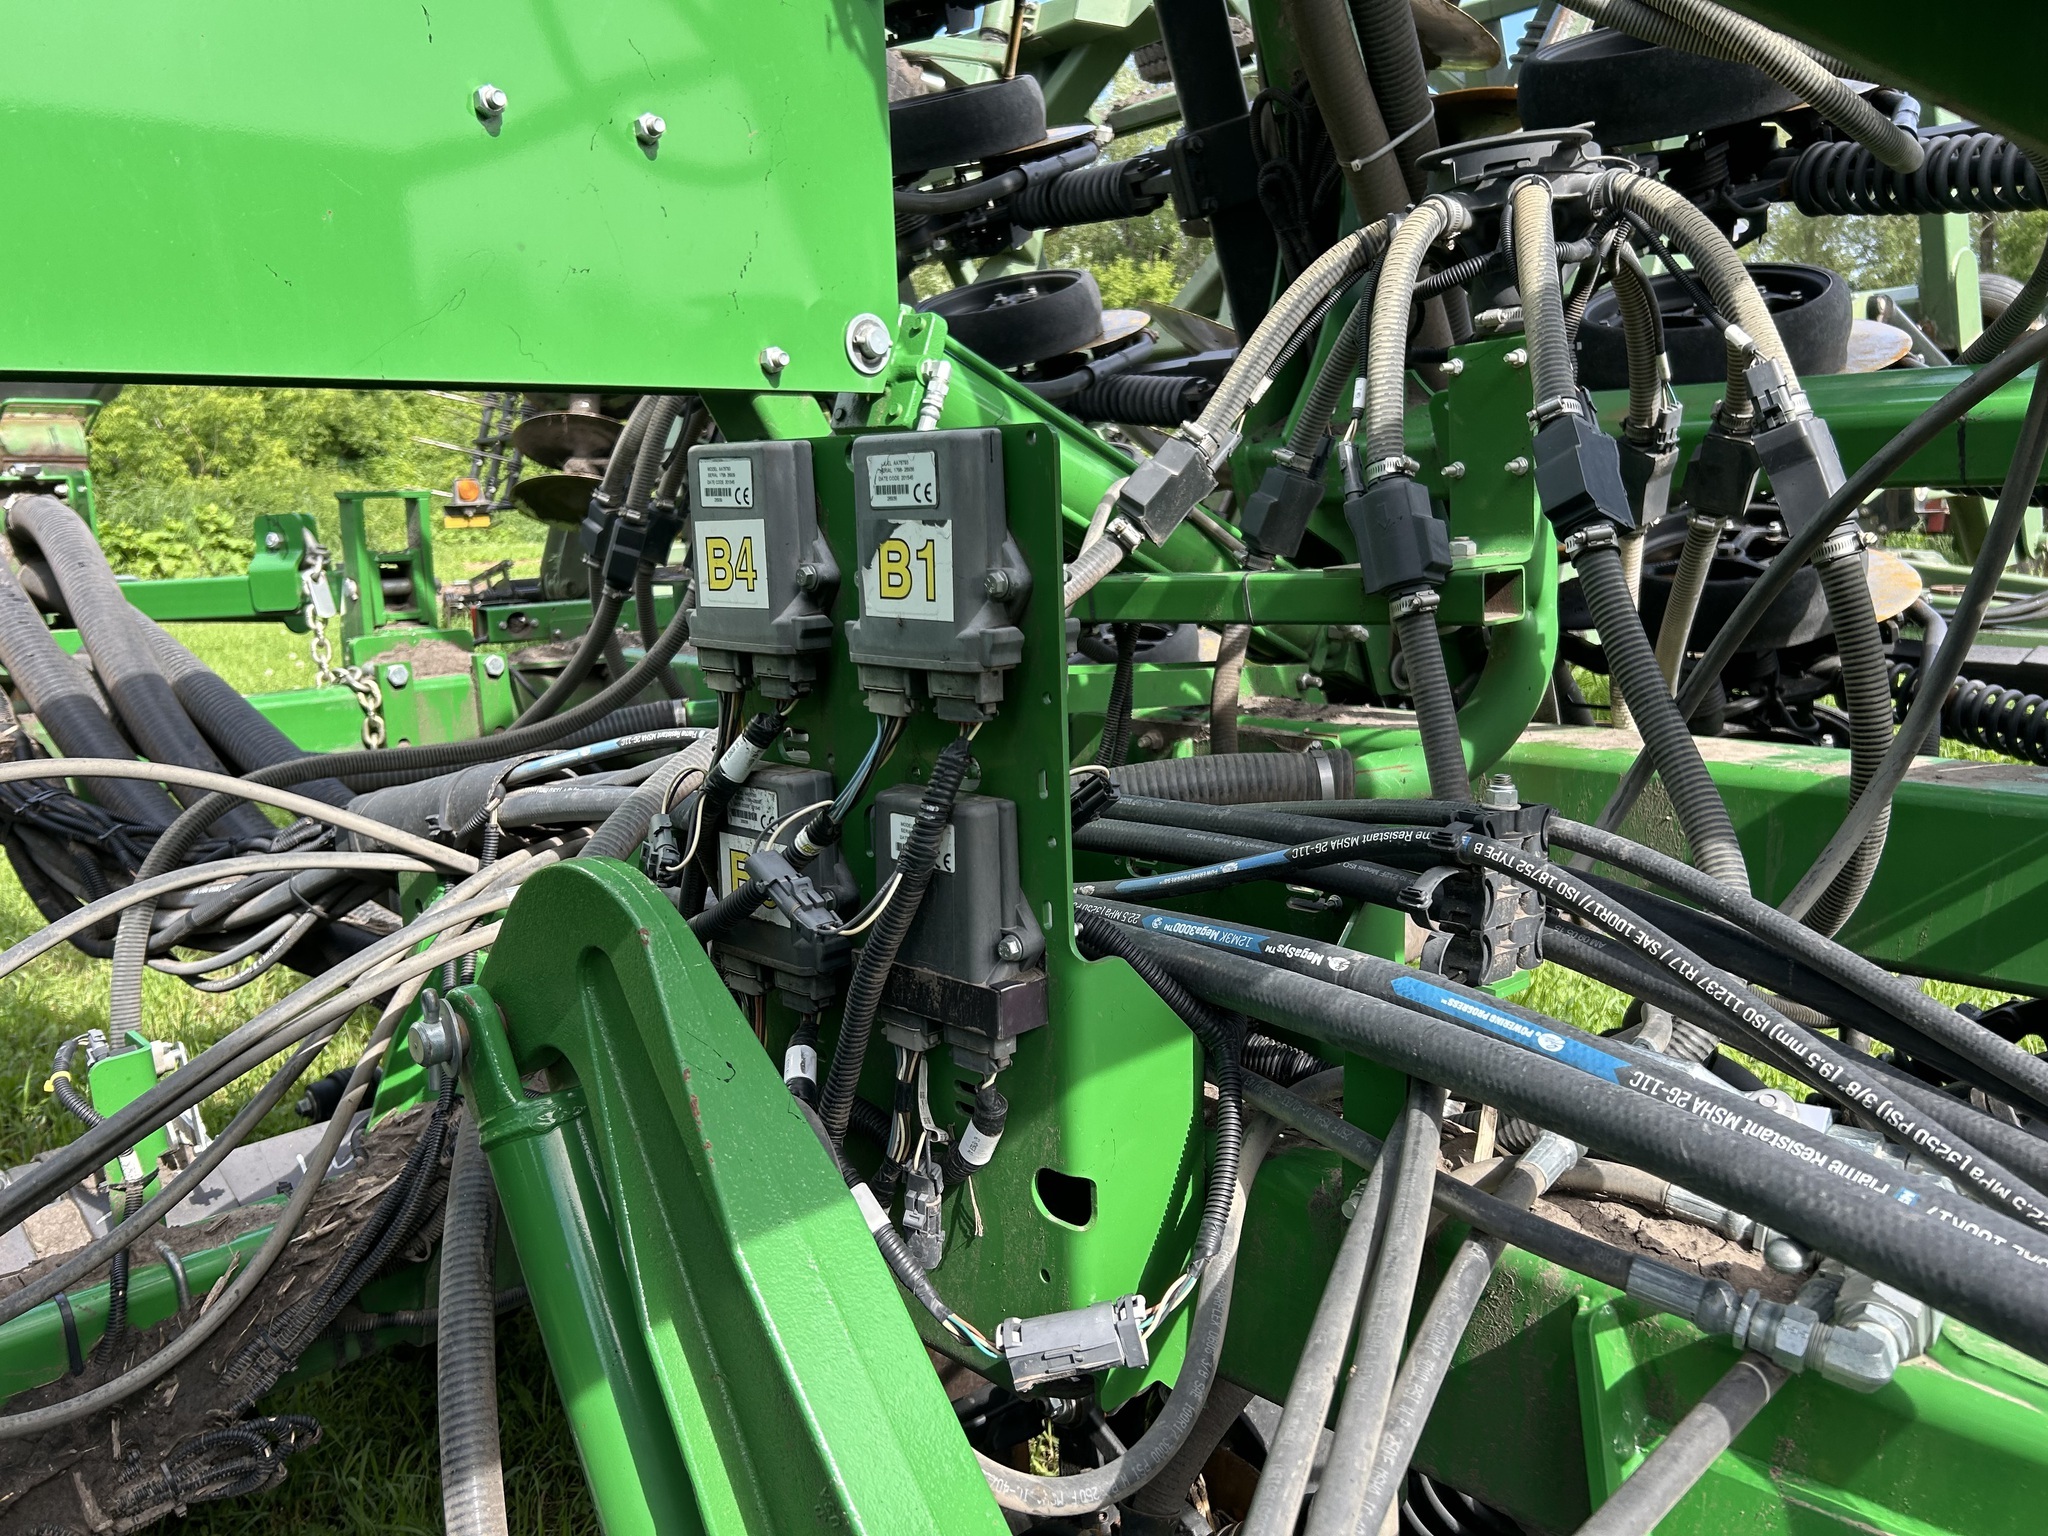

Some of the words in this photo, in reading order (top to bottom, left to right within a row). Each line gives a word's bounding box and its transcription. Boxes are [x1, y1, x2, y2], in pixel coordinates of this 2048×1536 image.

[735, 487, 750, 505] CE
[913, 482, 932, 503] CE
[705, 536, 758, 592] B4
[878, 538, 937, 603] B1
[1330, 836, 1361, 850] MSHA
[1361, 829, 1413, 844] Resistant
[1291, 842, 1328, 859] 2G-11C
[1473, 842, 1485, 855] B
[1484, 845, 1515, 868] TYPE
[1516, 859, 1558, 889] 18752
[1556, 881, 1583, 902] ISO
[1128, 912, 1142, 924] 22.5
[1218, 931, 1254, 948] 12M3K
[1590, 940, 1607, 949] AM
[1633, 930, 1662, 956] SAE
[1668, 956, 1699, 981] R17
[1697, 976, 1745, 1013] 11237
[1488, 1014, 1535, 1038] POWERING
[1742, 1007, 1771, 1033] ISO
[1628, 1070, 1693, 1109] 2G-11C
[1692, 1099, 1743, 1131] MSHA
[1741, 1119, 1826, 1168] Resistant
[1210, 1286, 1227, 1328] PARFLEX
[1196, 1357, 1213, 1379] 3/8
[1188, 1379, 1206, 1401] SAE
[1165, 1401, 1198, 1440] 100R17
[1147, 1435, 1174, 1465] 3000
[1128, 1457, 1153, 1480] PSI
